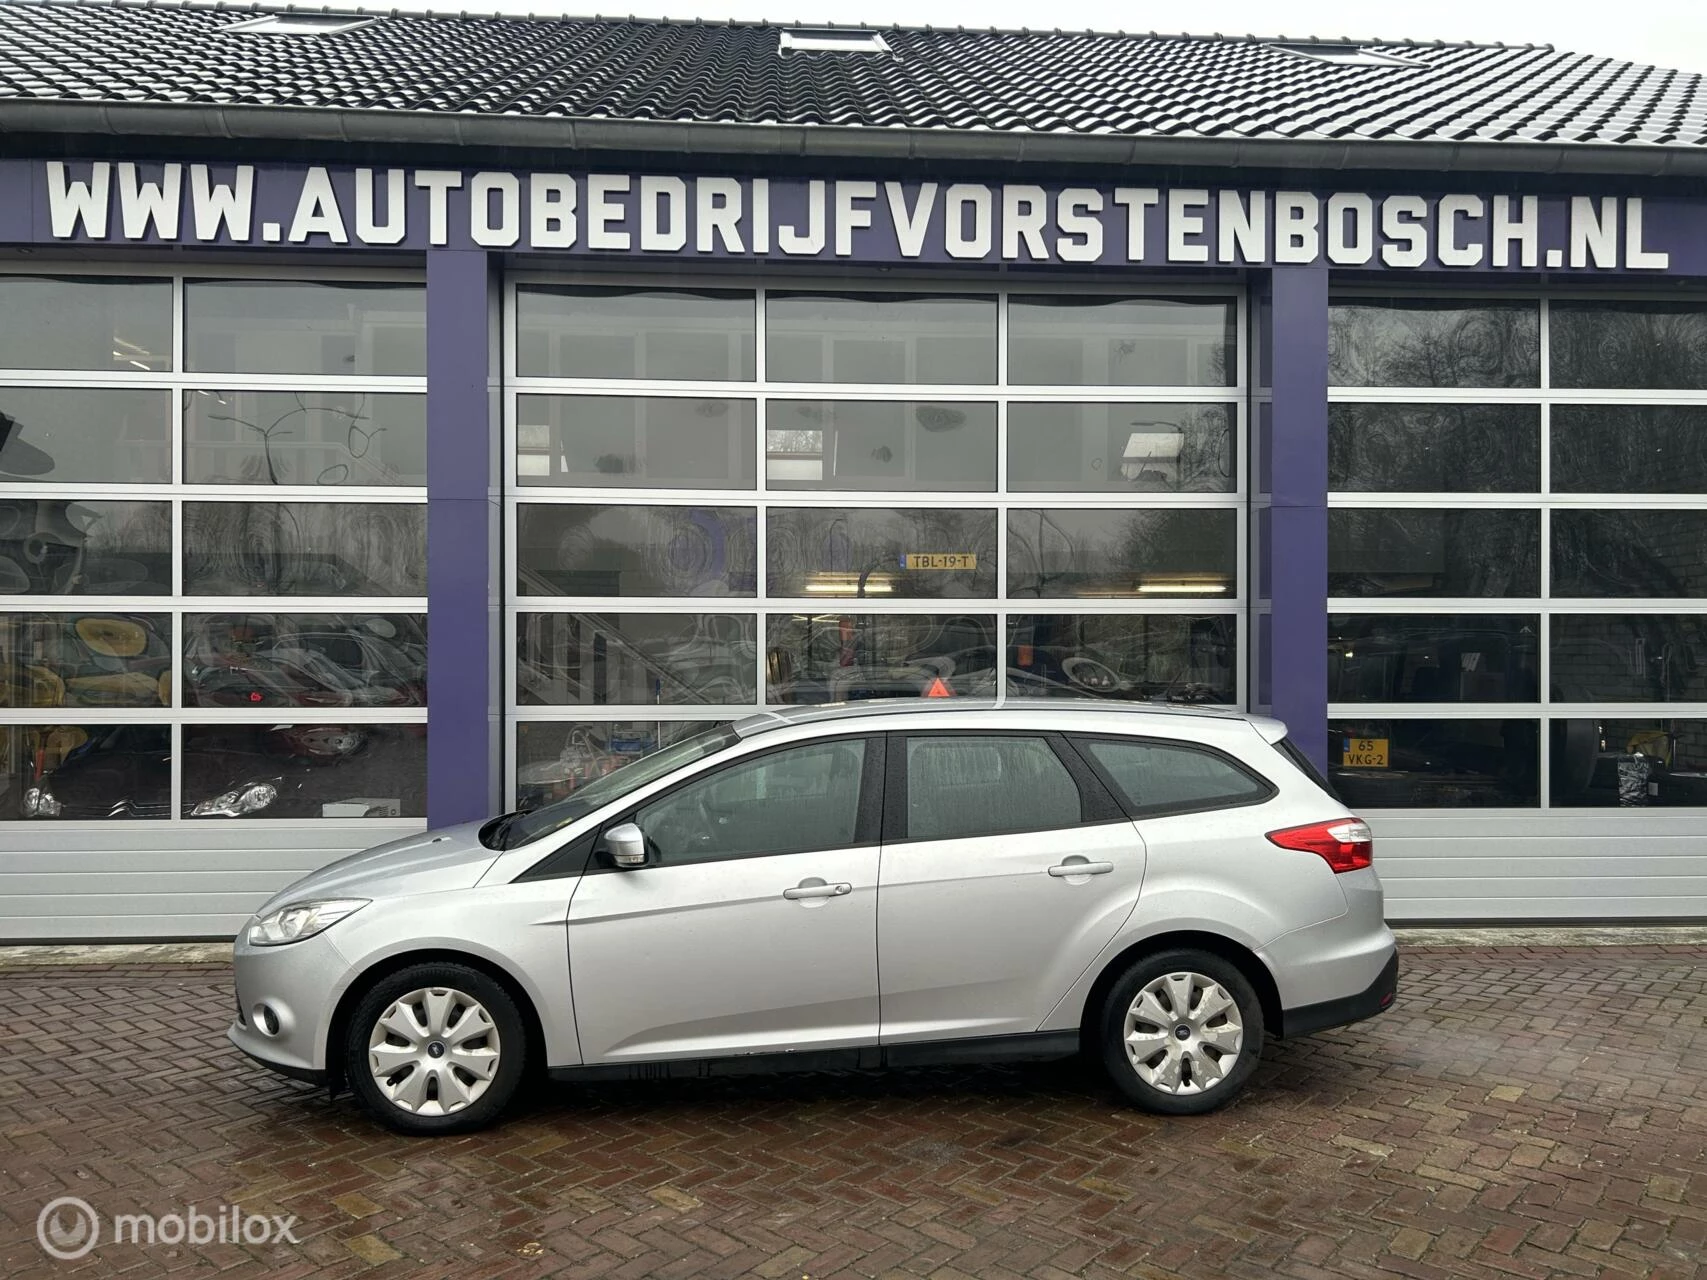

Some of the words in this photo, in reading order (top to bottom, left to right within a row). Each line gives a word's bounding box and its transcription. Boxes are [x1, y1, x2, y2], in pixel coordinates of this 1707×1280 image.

[46, 160, 1670, 270] WWW.AUTOBEDRIJFVORSTENBOSCH.NL
[913, 555, 969, 568] TBL-19-T
[1358, 740, 1374, 751] 65
[1348, 753, 1384, 765] VKG-2
